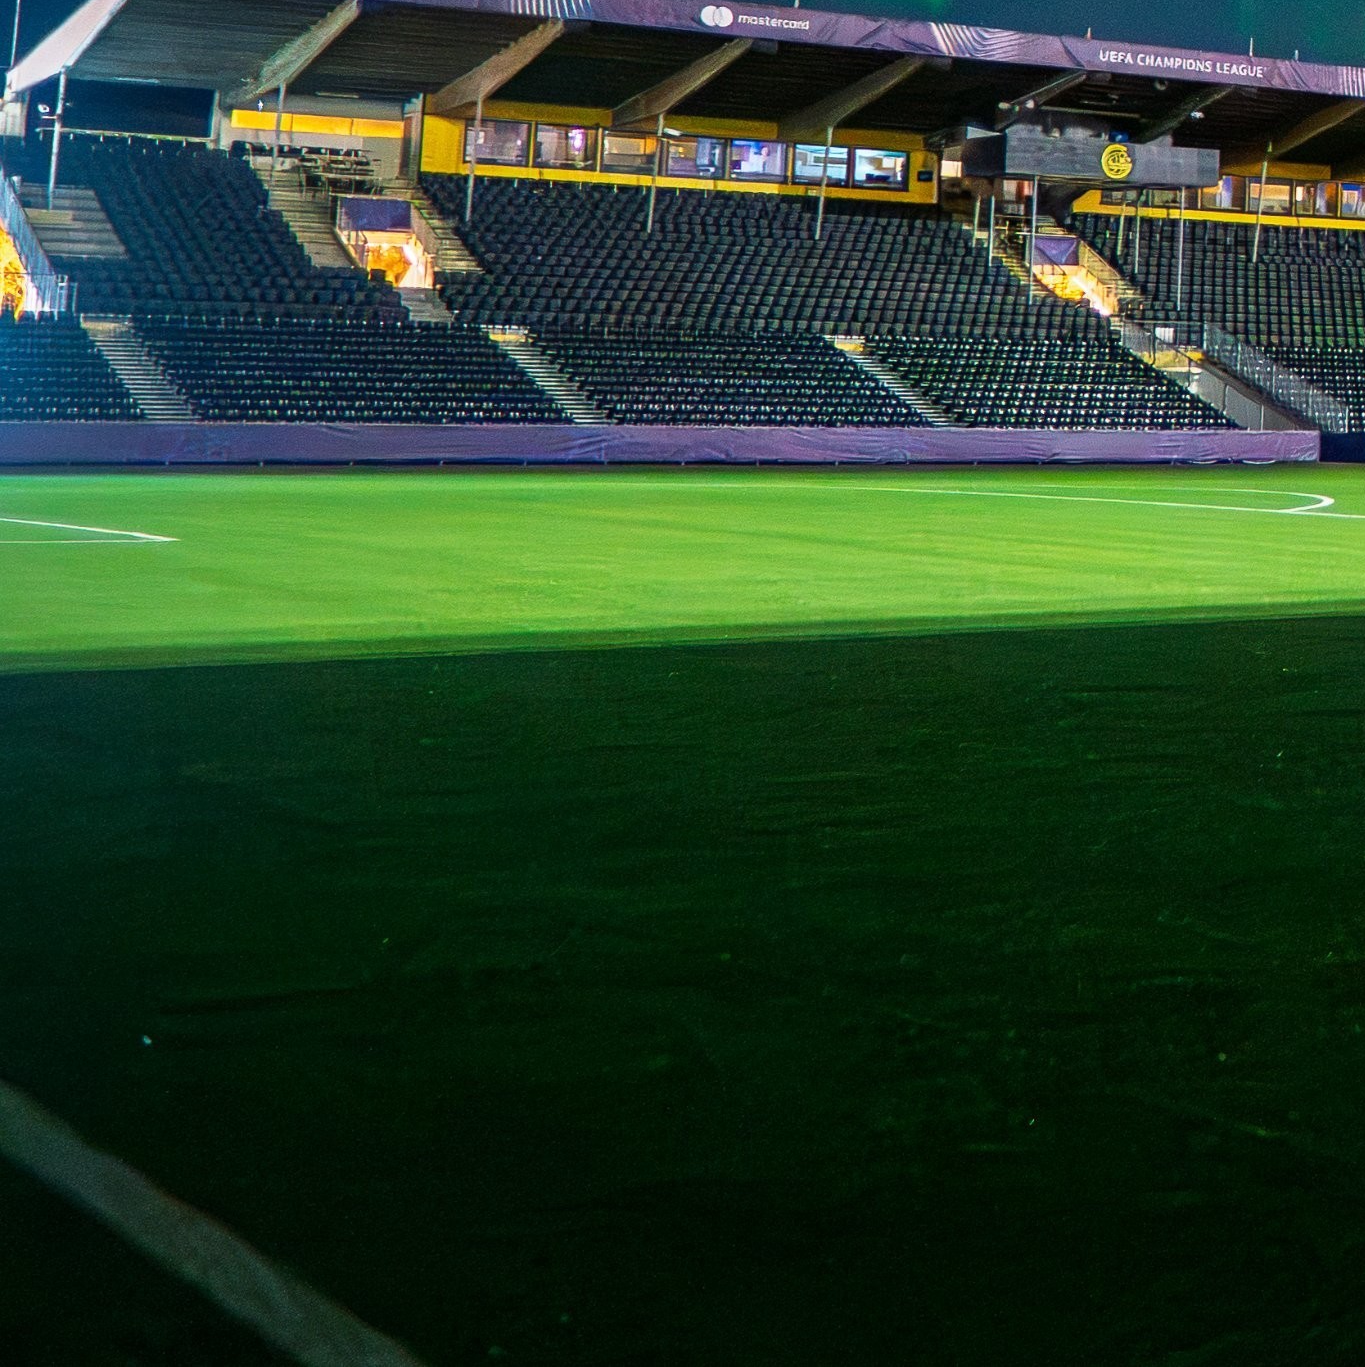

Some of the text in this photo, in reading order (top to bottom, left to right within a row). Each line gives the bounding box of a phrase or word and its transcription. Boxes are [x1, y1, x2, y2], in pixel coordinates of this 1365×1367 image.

[738, 15, 810, 30] mastercard
[1099, 49, 1264, 78] UEFA CHAMPIONS LEAGUE
